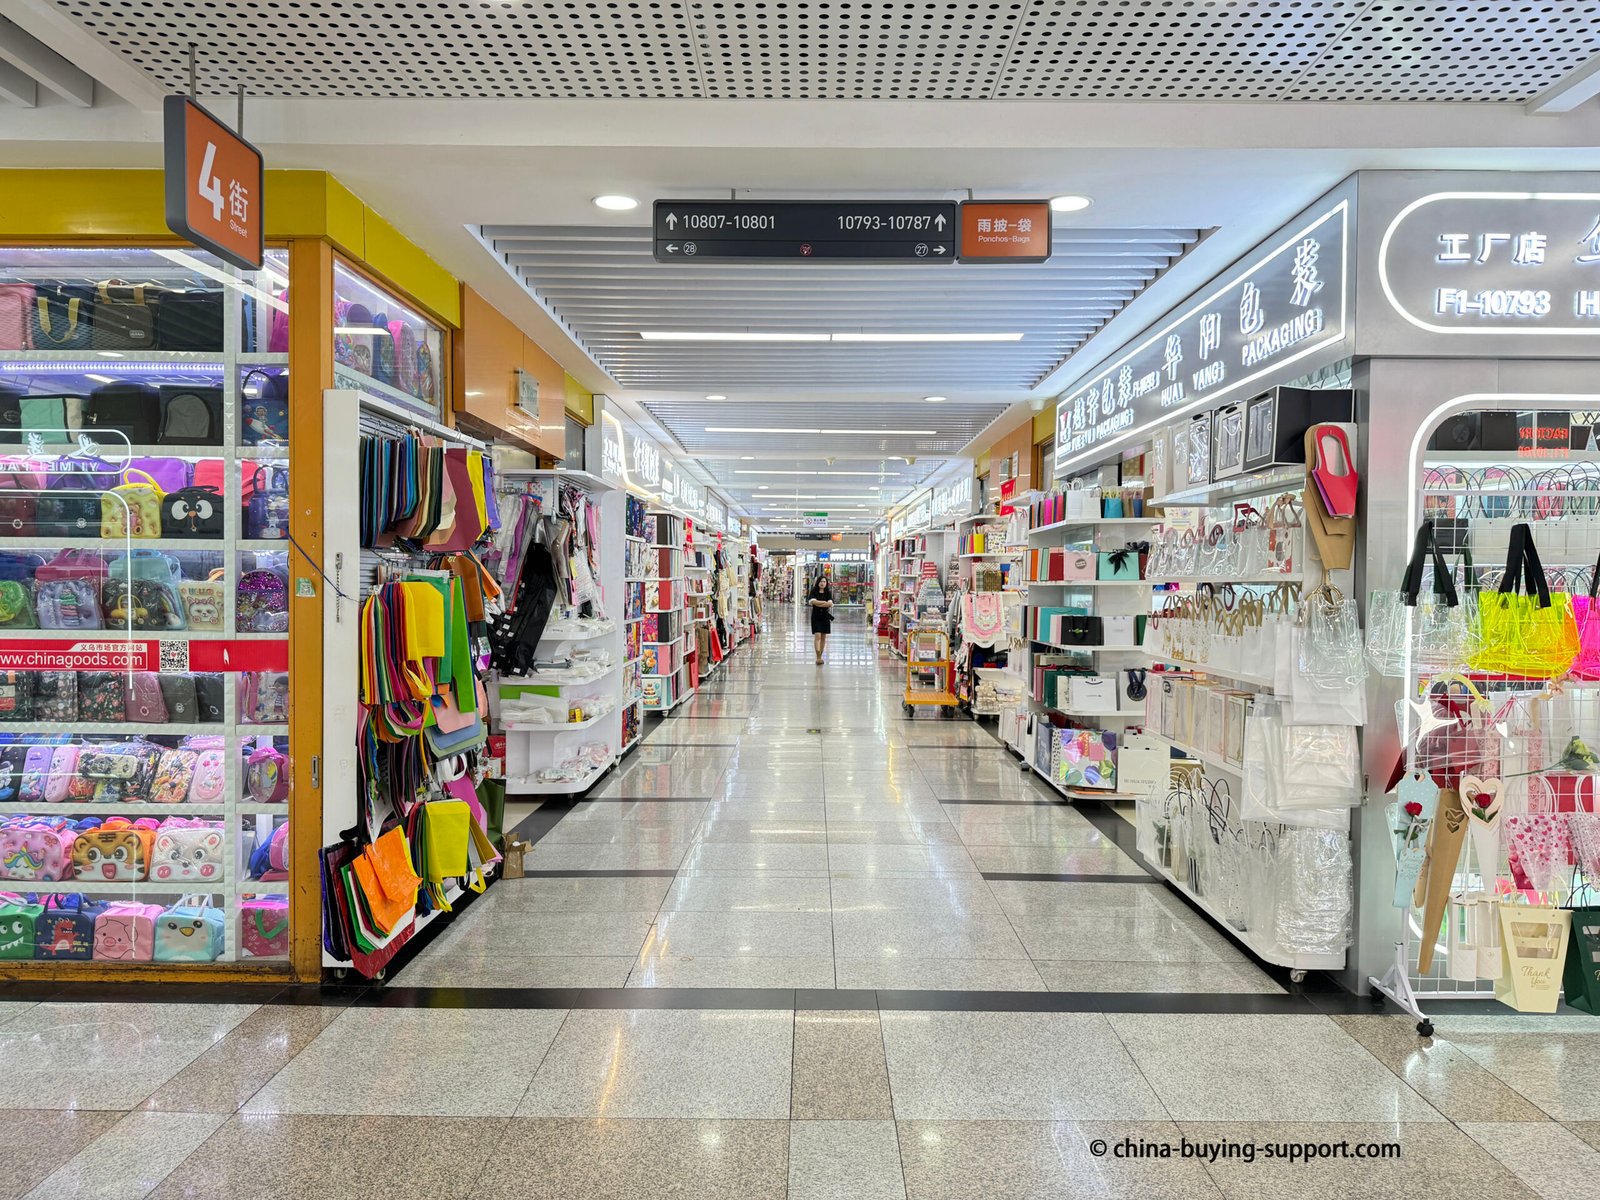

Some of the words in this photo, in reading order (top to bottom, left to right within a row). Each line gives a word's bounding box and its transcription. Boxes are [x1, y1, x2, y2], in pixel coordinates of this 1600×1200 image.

[229, 219, 248, 238] Street
[683, 215, 775, 230] 10807-10801
[838, 215, 931, 230] 10793-10787
[978, 235, 1030, 243] Ponchos-Bags
[684, 243, 696, 254] 28
[916, 243, 928, 254] 27
[1438, 231, 1547, 263] 工厂店
[1437, 289, 1551, 315] F1-10793
[1192, 361, 1225, 390] YANG
[1242, 309, 1323, 366] PACKAGING
[1521, 965, 1551, 979] Thank
